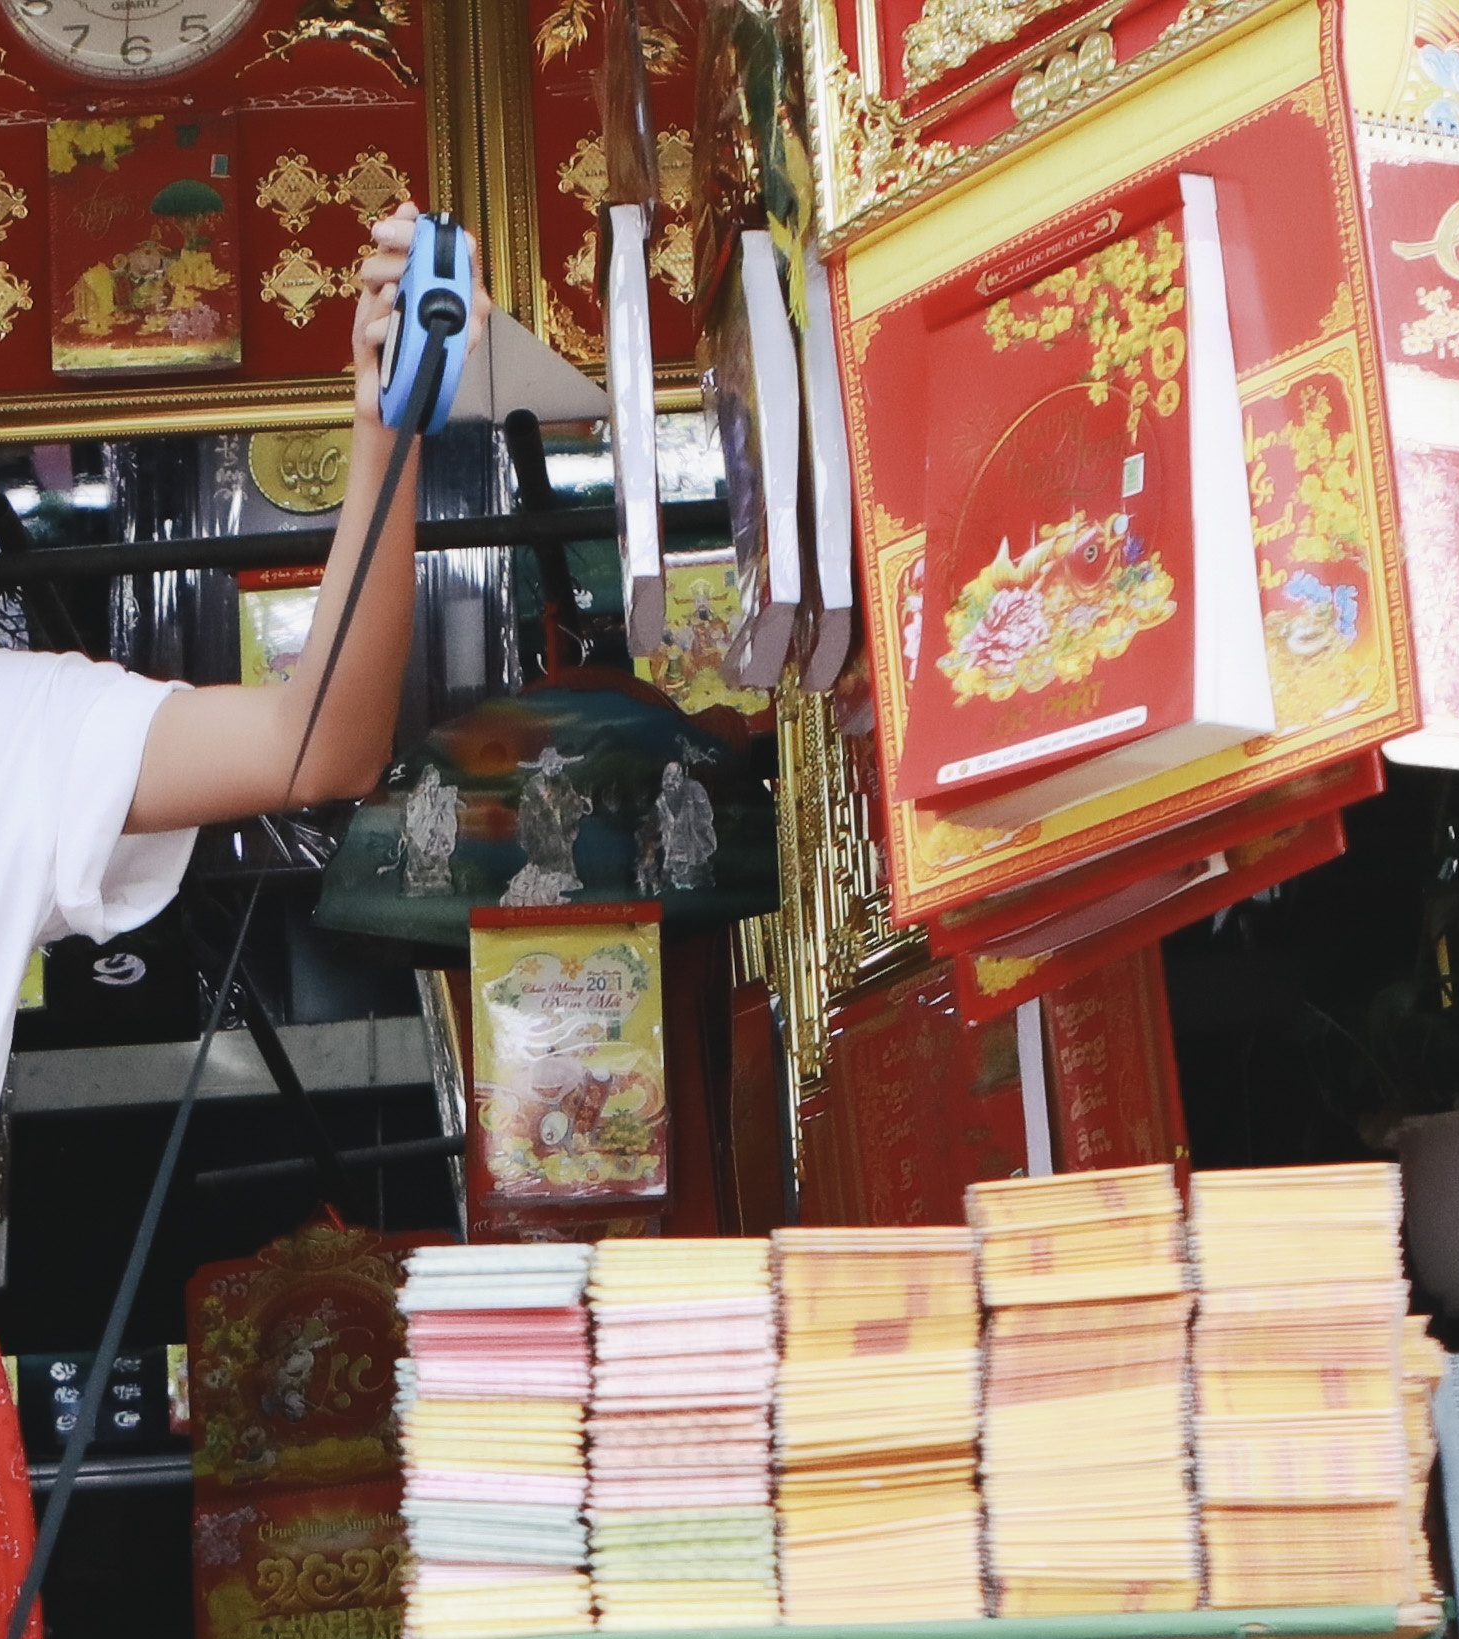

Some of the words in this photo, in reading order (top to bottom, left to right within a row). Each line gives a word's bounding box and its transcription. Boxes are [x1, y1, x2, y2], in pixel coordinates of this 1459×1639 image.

[62, 24, 89, 53] 7
[179, 14, 211, 42] 5
[120, 36, 152, 65] 6
